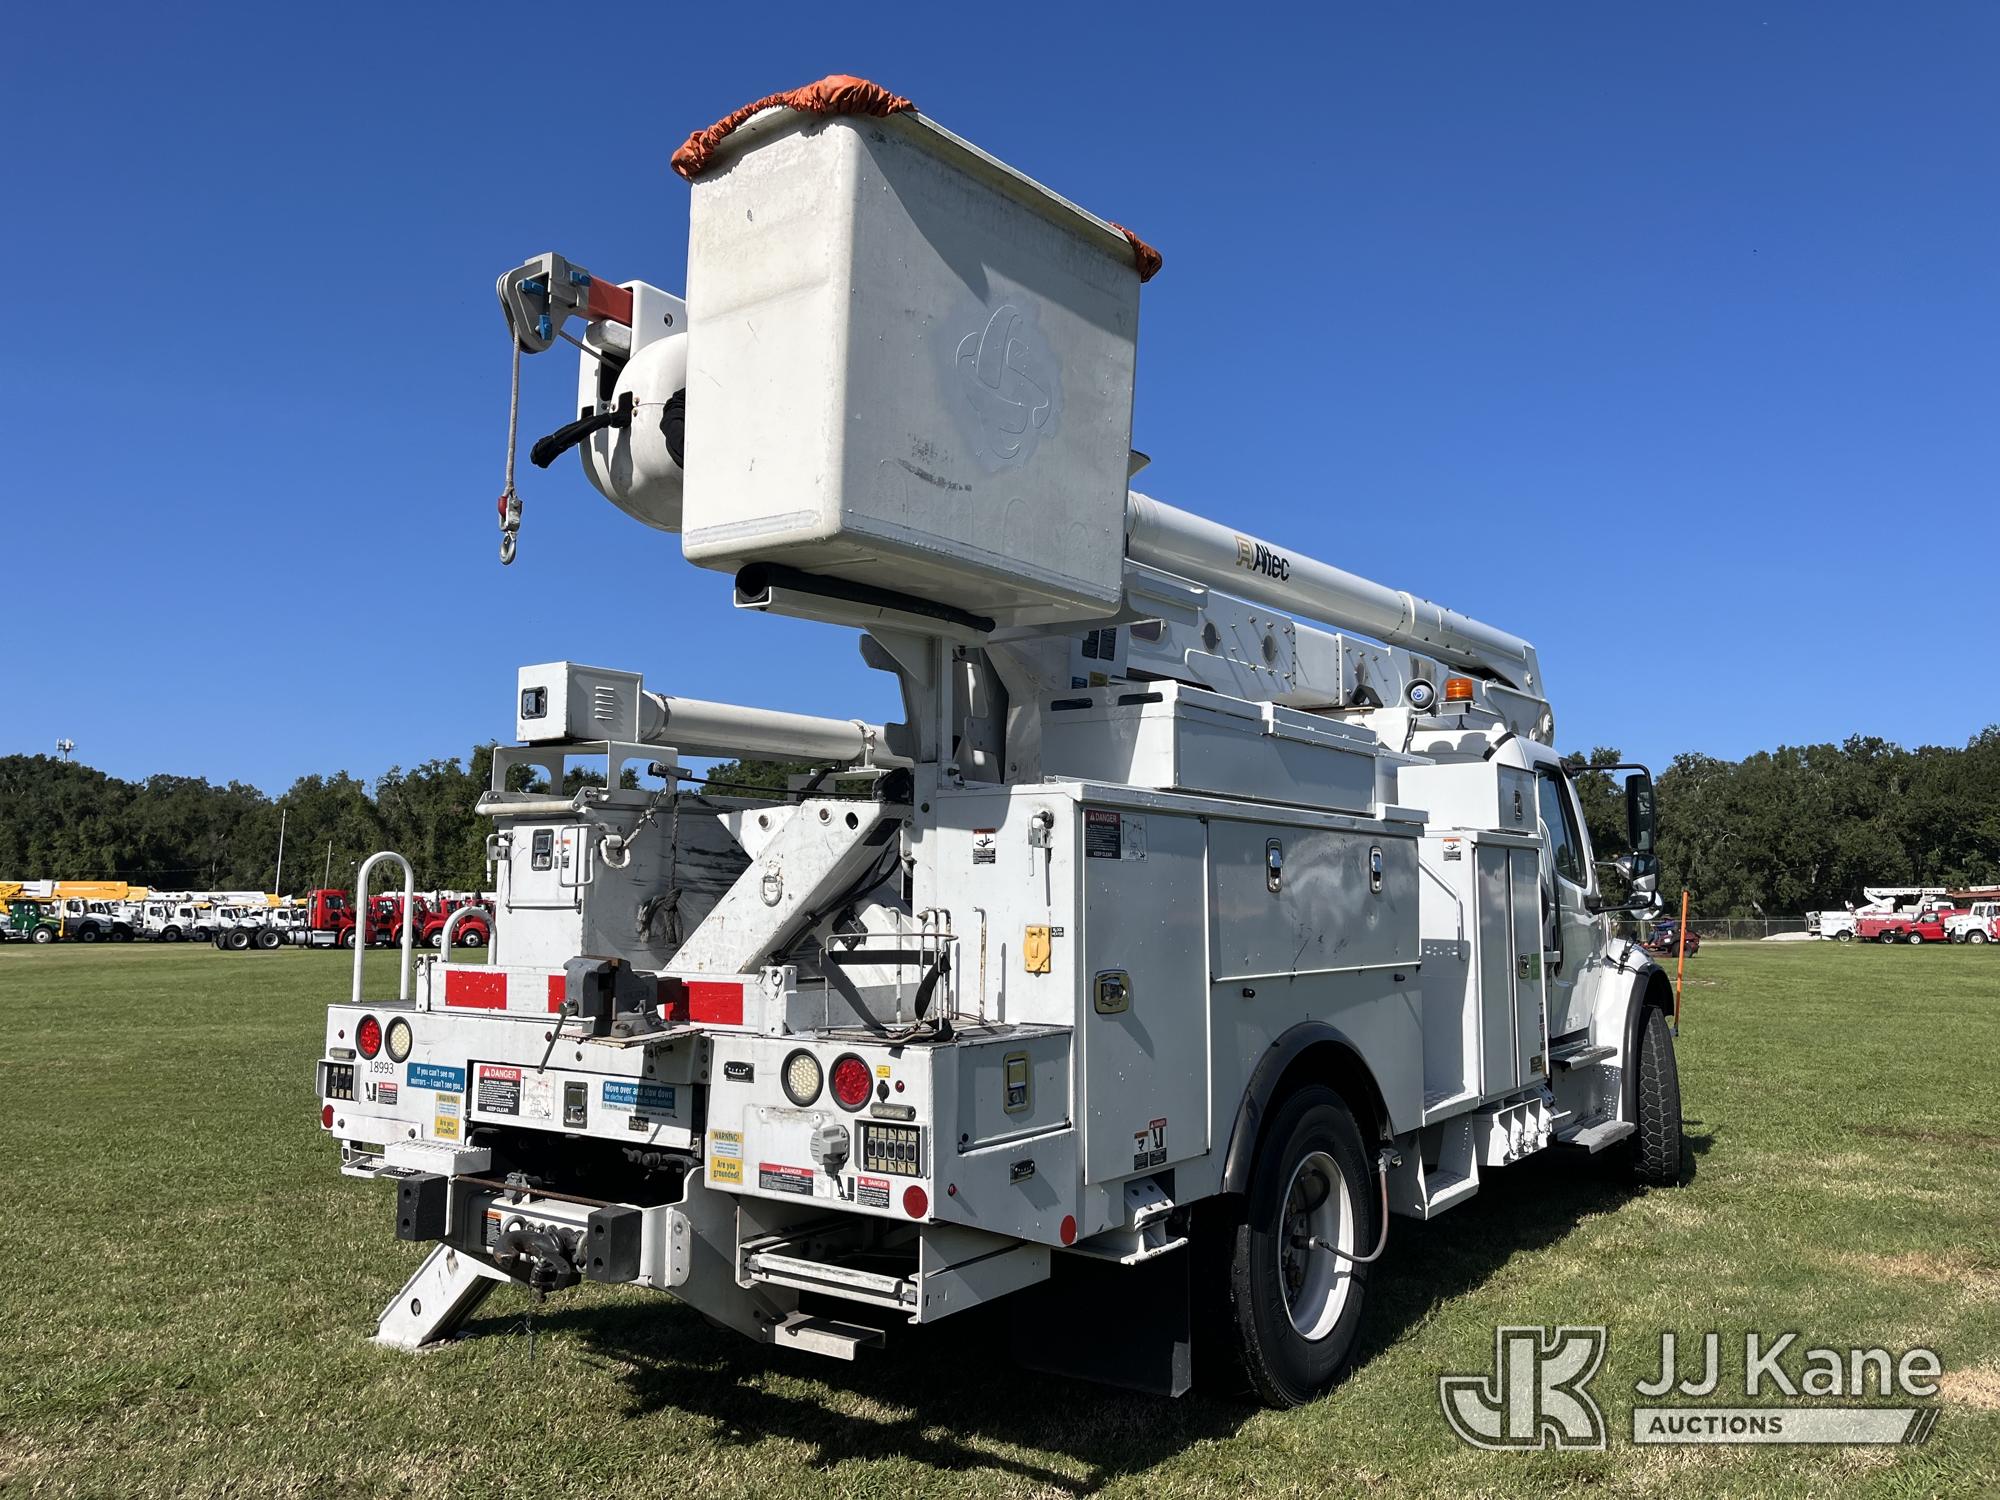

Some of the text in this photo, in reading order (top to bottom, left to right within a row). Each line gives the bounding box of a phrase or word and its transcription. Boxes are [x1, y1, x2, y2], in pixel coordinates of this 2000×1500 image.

[1252, 543, 1290, 581] Altec
[1095, 812, 1117, 823] DANGER
[369, 1060, 394, 1075] 18993
[416, 1066, 421, 1074] If
[420, 1068, 428, 1076] you
[428, 1068, 440, 1077] can't
[448, 1072, 455, 1080] my
[490, 1068, 517, 1079] DANGER
[410, 1077, 426, 1086] mirrors
[433, 1080, 444, 1089] can't
[605, 1083, 673, 1099] Move over and slow down
[713, 1130, 740, 1142] WARNING!
[717, 1160, 736, 1171] Are you
[784, 1167, 802, 1175] DANGER
[713, 1169, 740, 1179] grounded?
[867, 1179, 888, 1188] DANGER
